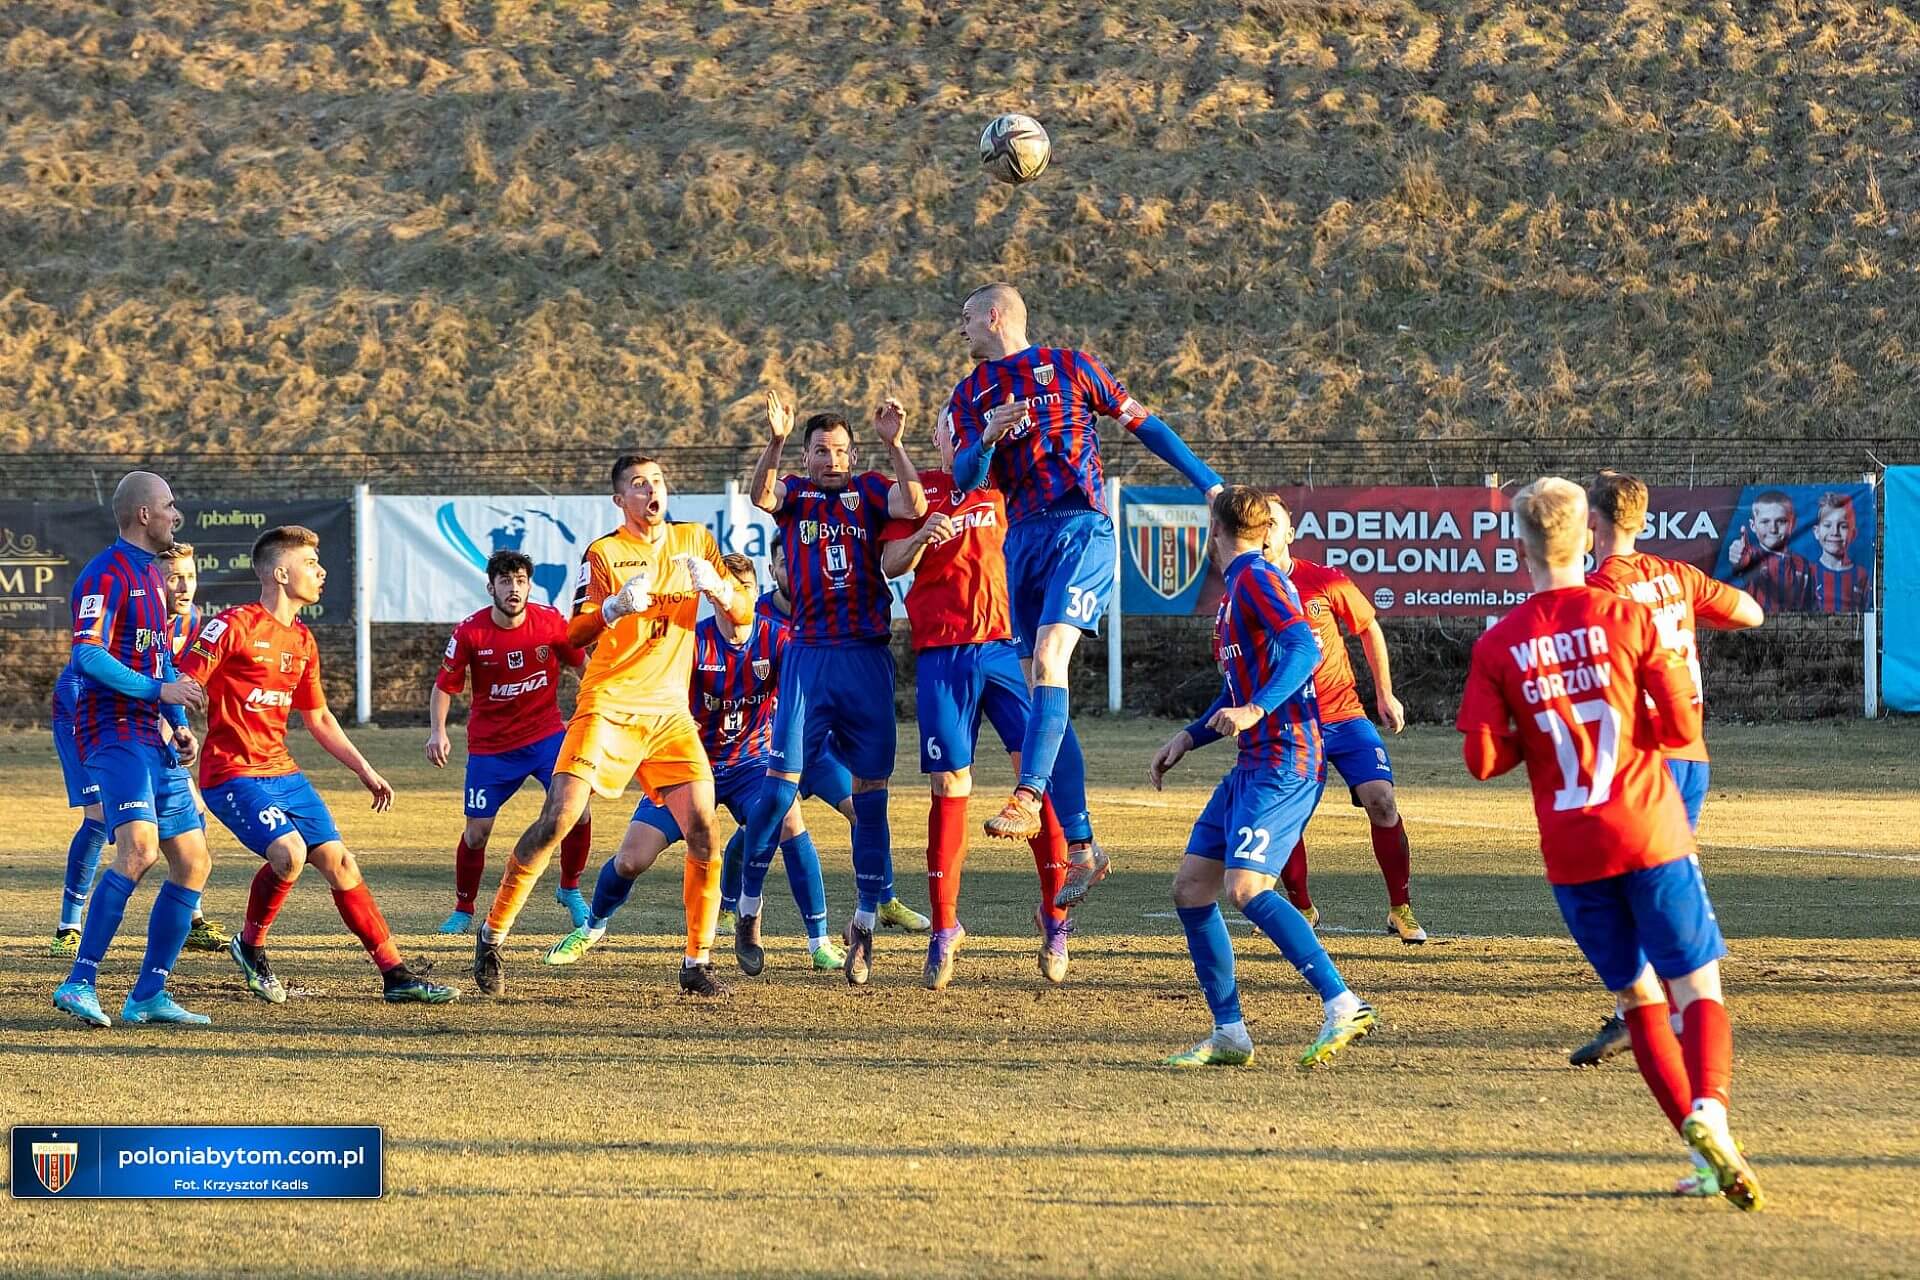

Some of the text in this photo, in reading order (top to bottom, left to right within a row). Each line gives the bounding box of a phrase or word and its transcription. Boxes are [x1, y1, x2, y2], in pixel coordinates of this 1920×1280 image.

[952, 510, 997, 534] ENA
[1137, 508, 1199, 522] POLONIA
[1294, 510, 1463, 541] ADEMIA
[613, 560, 648, 568] LEGEA
[1163, 529, 1175, 591] BYTOM
[1326, 547, 1486, 574] POLONIA
[1065, 586, 1098, 623] 30
[1509, 625, 1610, 672] WARTA
[698, 663, 727, 673] LEGEA
[490, 675, 549, 697] MENA
[1522, 661, 1612, 705] GORZÓW
[927, 736, 942, 761] 6
[1533, 698, 1623, 811] 17
[467, 787, 488, 810] 16
[258, 806, 288, 832] 99
[1233, 825, 1271, 864] 22
